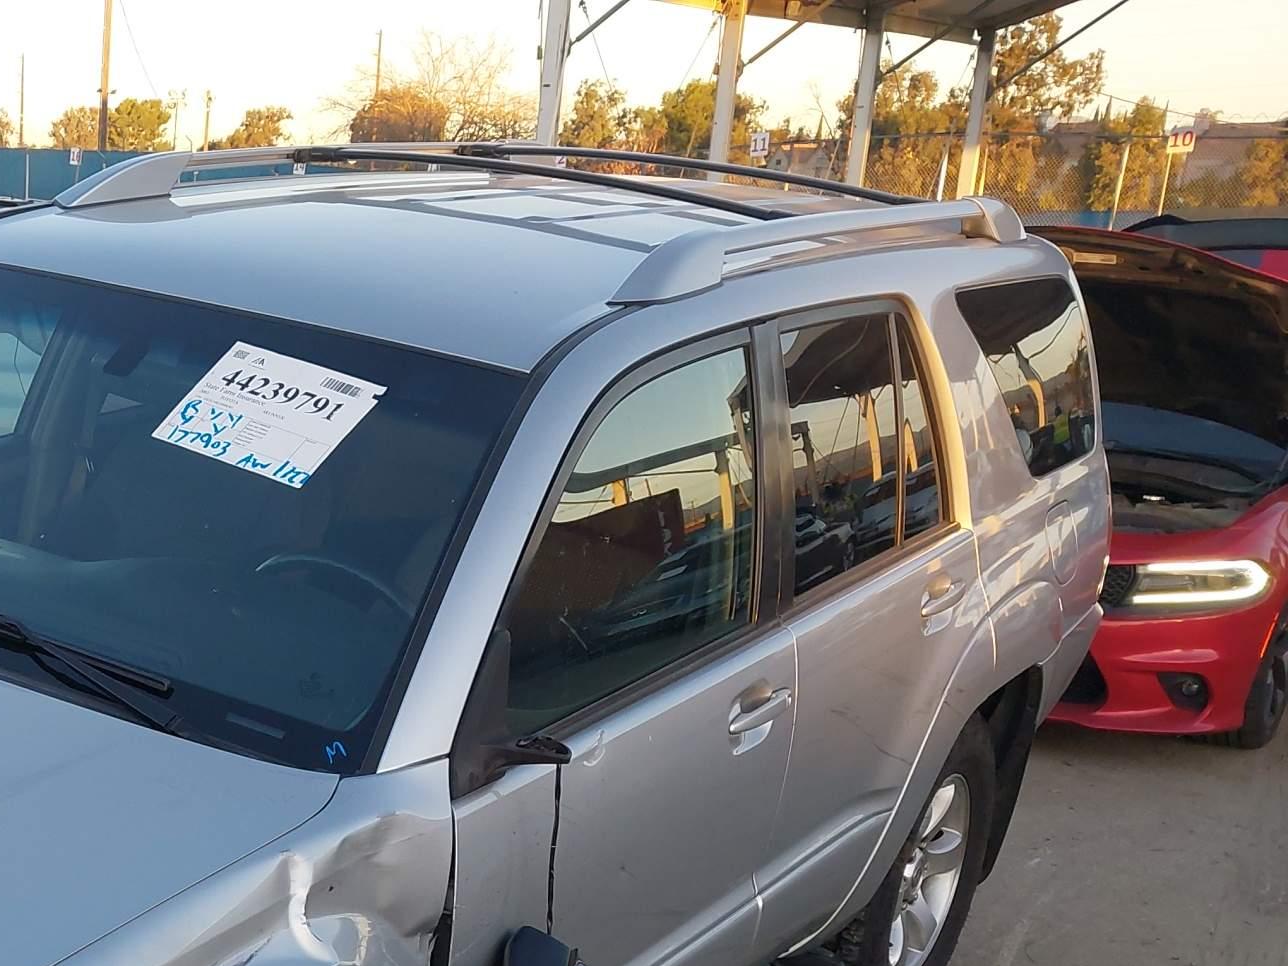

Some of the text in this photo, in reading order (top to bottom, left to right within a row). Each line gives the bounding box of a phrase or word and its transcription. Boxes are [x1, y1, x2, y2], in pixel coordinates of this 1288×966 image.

[752, 137, 767, 152] 11
[1169, 130, 1194, 148] 10
[221, 369, 345, 422] 44239791
[168, 425, 231, 456] 177903
